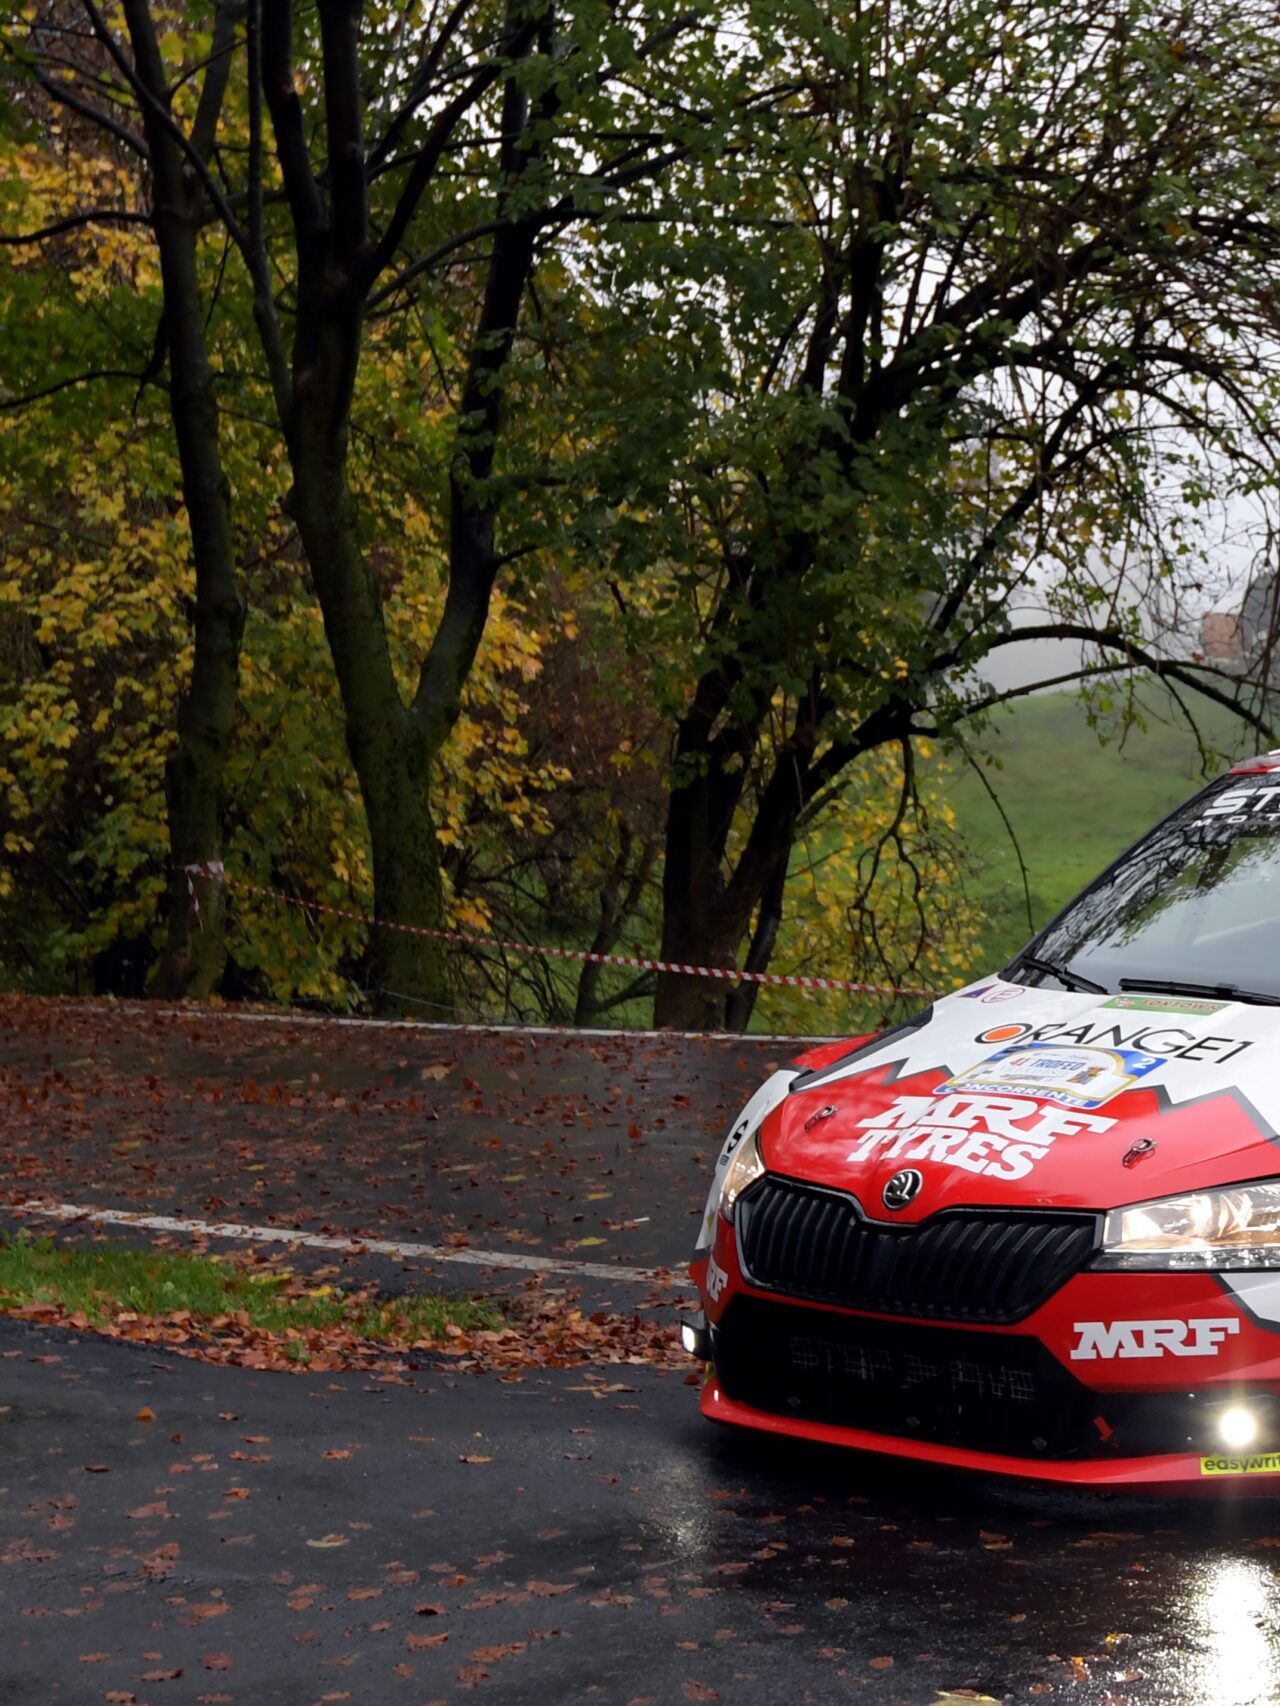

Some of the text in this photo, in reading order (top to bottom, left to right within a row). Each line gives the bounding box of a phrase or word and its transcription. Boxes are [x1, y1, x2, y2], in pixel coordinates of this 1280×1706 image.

[974, 1021, 1255, 1064] ORANGE1
[1132, 1057, 1158, 1070] 2
[855, 1093, 1119, 1146] MRF
[846, 1126, 1051, 1181] TYRES
[1070, 1318, 1240, 1360] MRF
